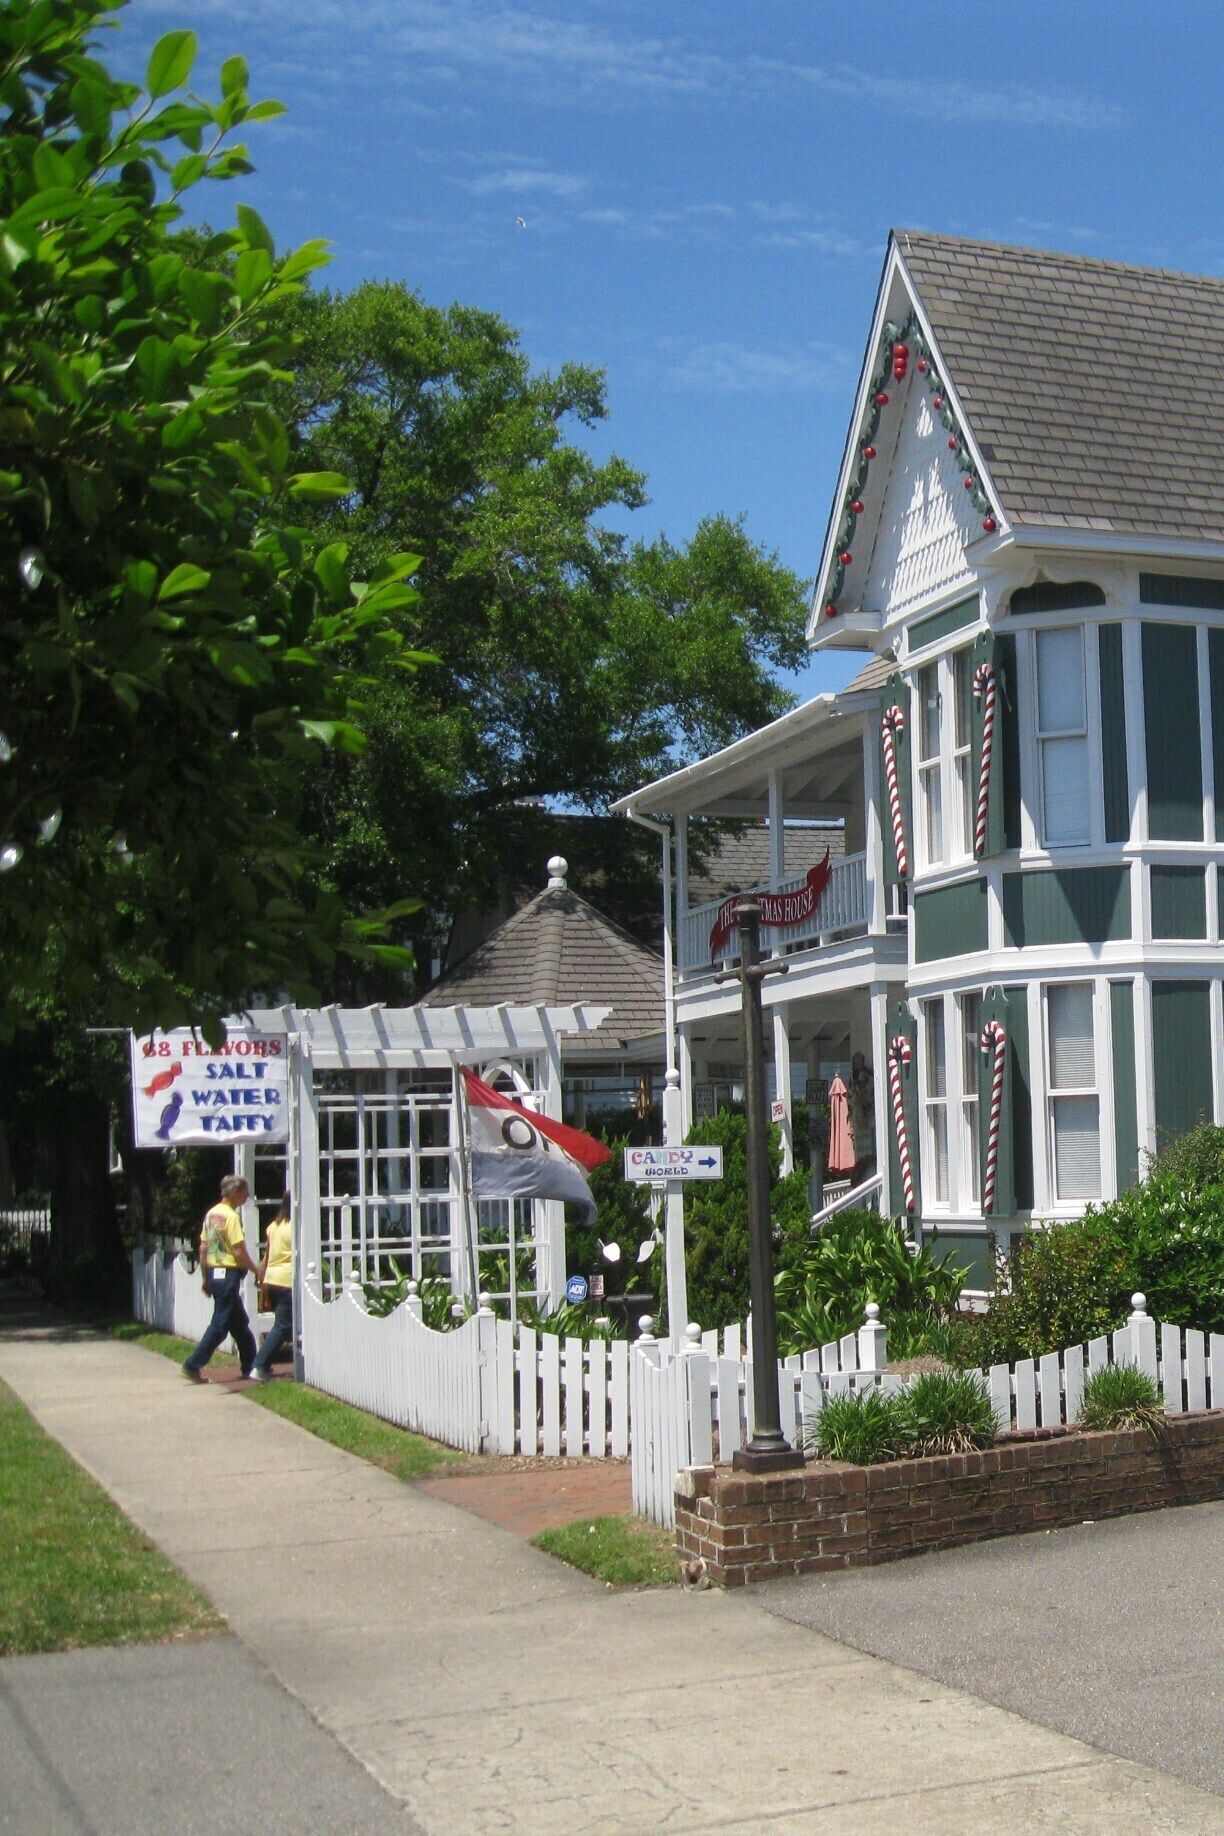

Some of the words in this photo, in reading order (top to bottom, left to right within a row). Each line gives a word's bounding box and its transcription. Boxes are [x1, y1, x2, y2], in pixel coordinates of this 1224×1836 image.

[720, 900, 735, 932] THE
[784, 884, 814, 923] HOUSE
[204, 1061, 269, 1080] SALT
[191, 1087, 282, 1106] WATER
[199, 1113, 276, 1132] TAFFY
[631, 1150, 694, 1165] CANDY
[645, 1167, 689, 1176] WORLD
[569, 1284, 585, 1295] ADT
